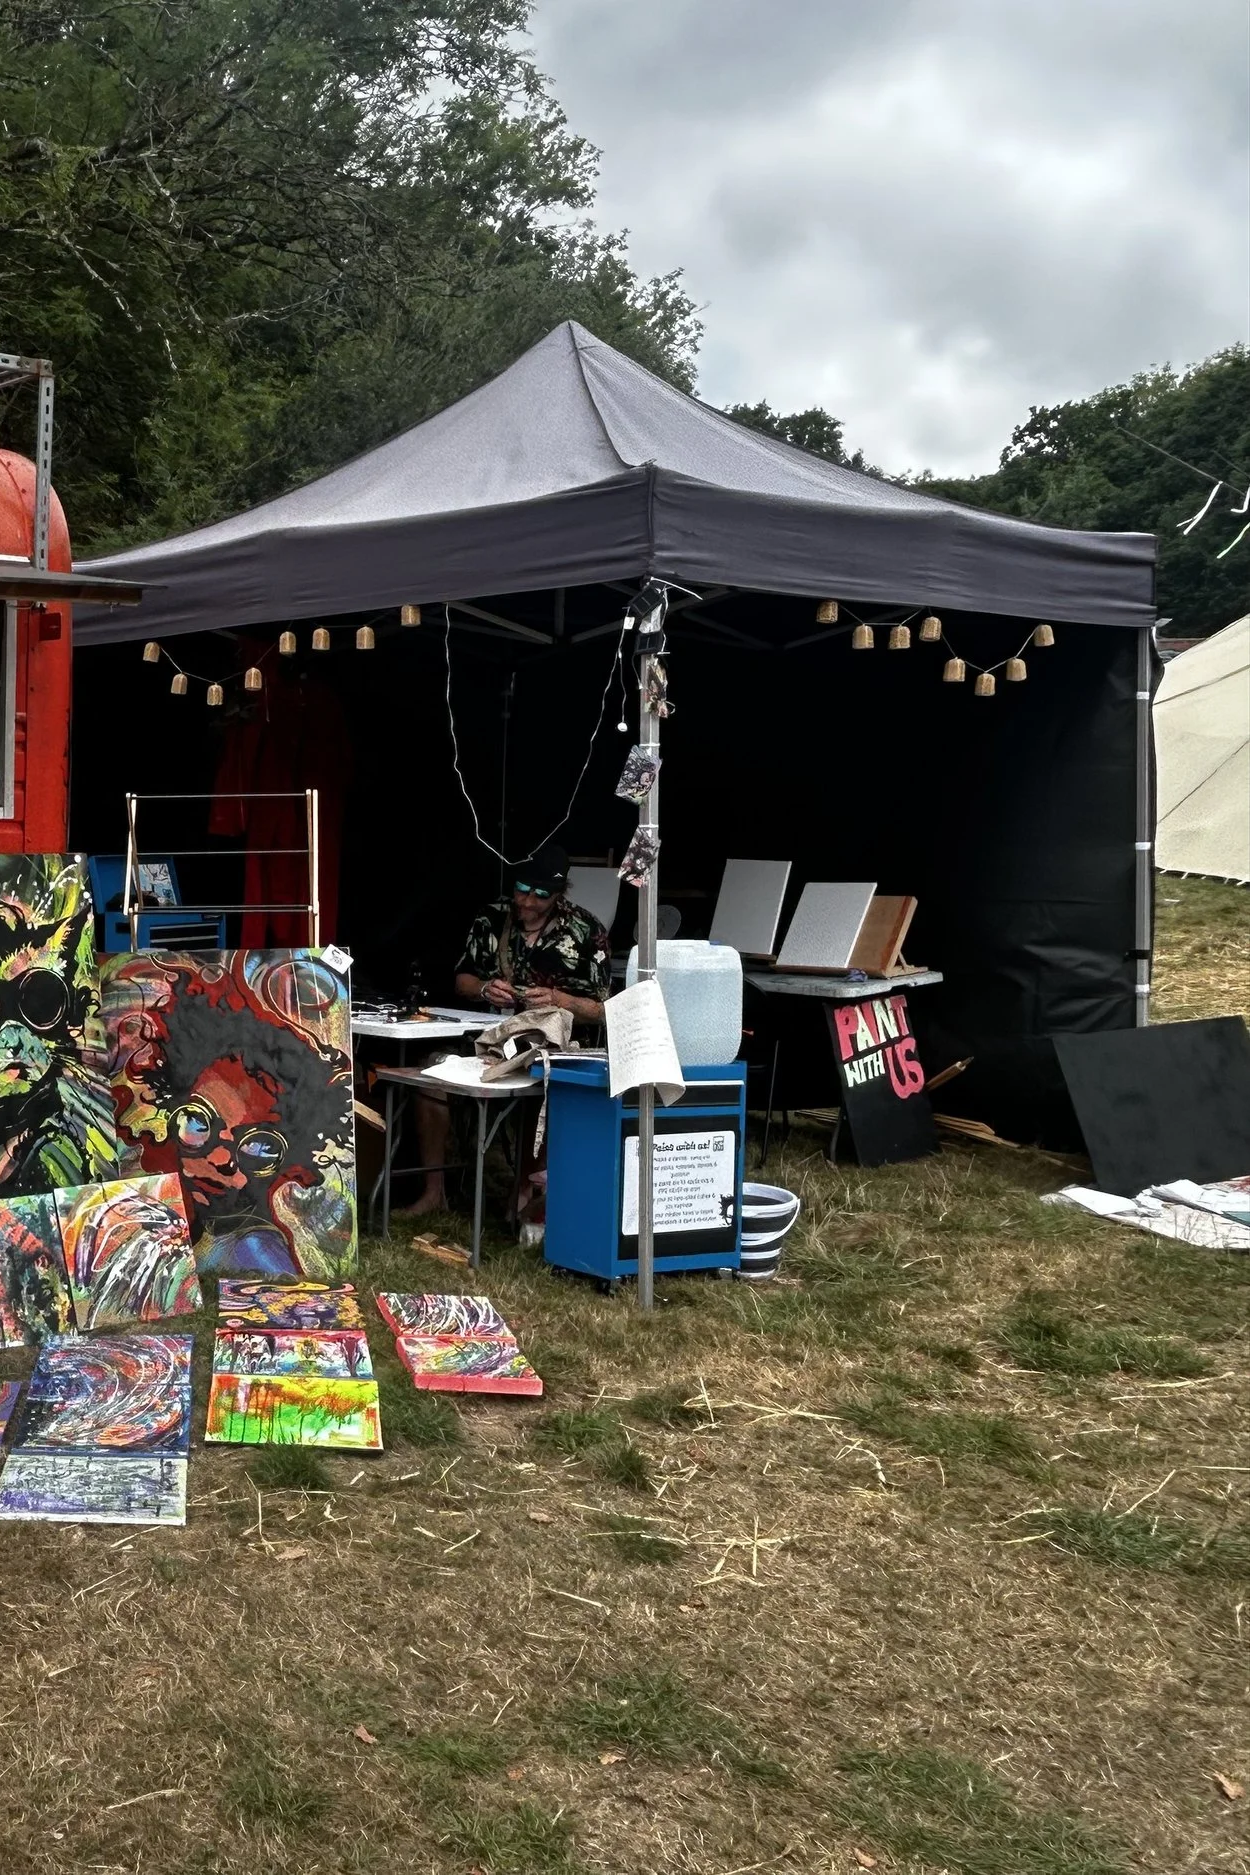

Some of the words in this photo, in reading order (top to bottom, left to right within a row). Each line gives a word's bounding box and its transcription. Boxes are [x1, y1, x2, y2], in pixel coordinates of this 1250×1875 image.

[834, 994, 910, 1061] PAINT
[844, 1050, 886, 1087] WITH
[885, 1037, 926, 1099] US
